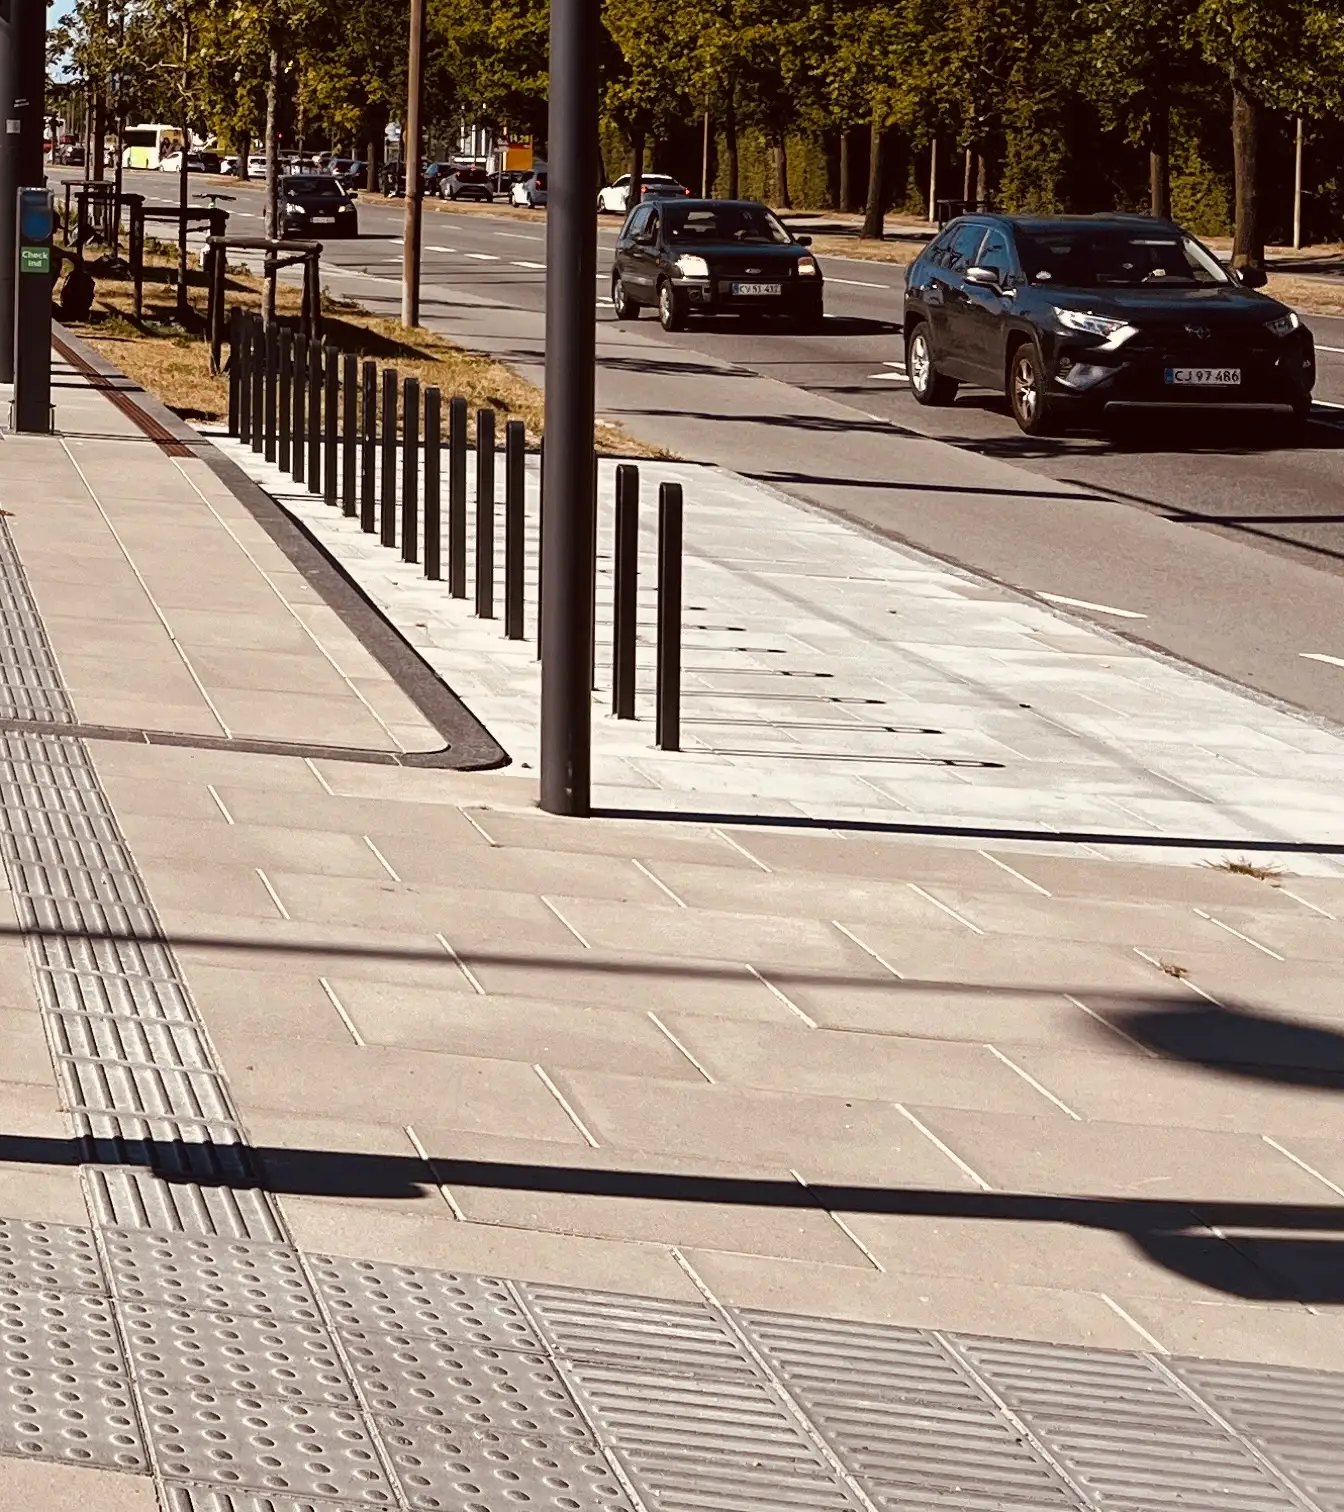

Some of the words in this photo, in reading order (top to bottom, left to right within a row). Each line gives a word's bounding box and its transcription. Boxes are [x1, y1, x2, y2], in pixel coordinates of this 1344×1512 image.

[22, 251, 48, 259] Check
[1174, 371, 1192, 382] CJ
[1215, 370, 1240, 383] 486
